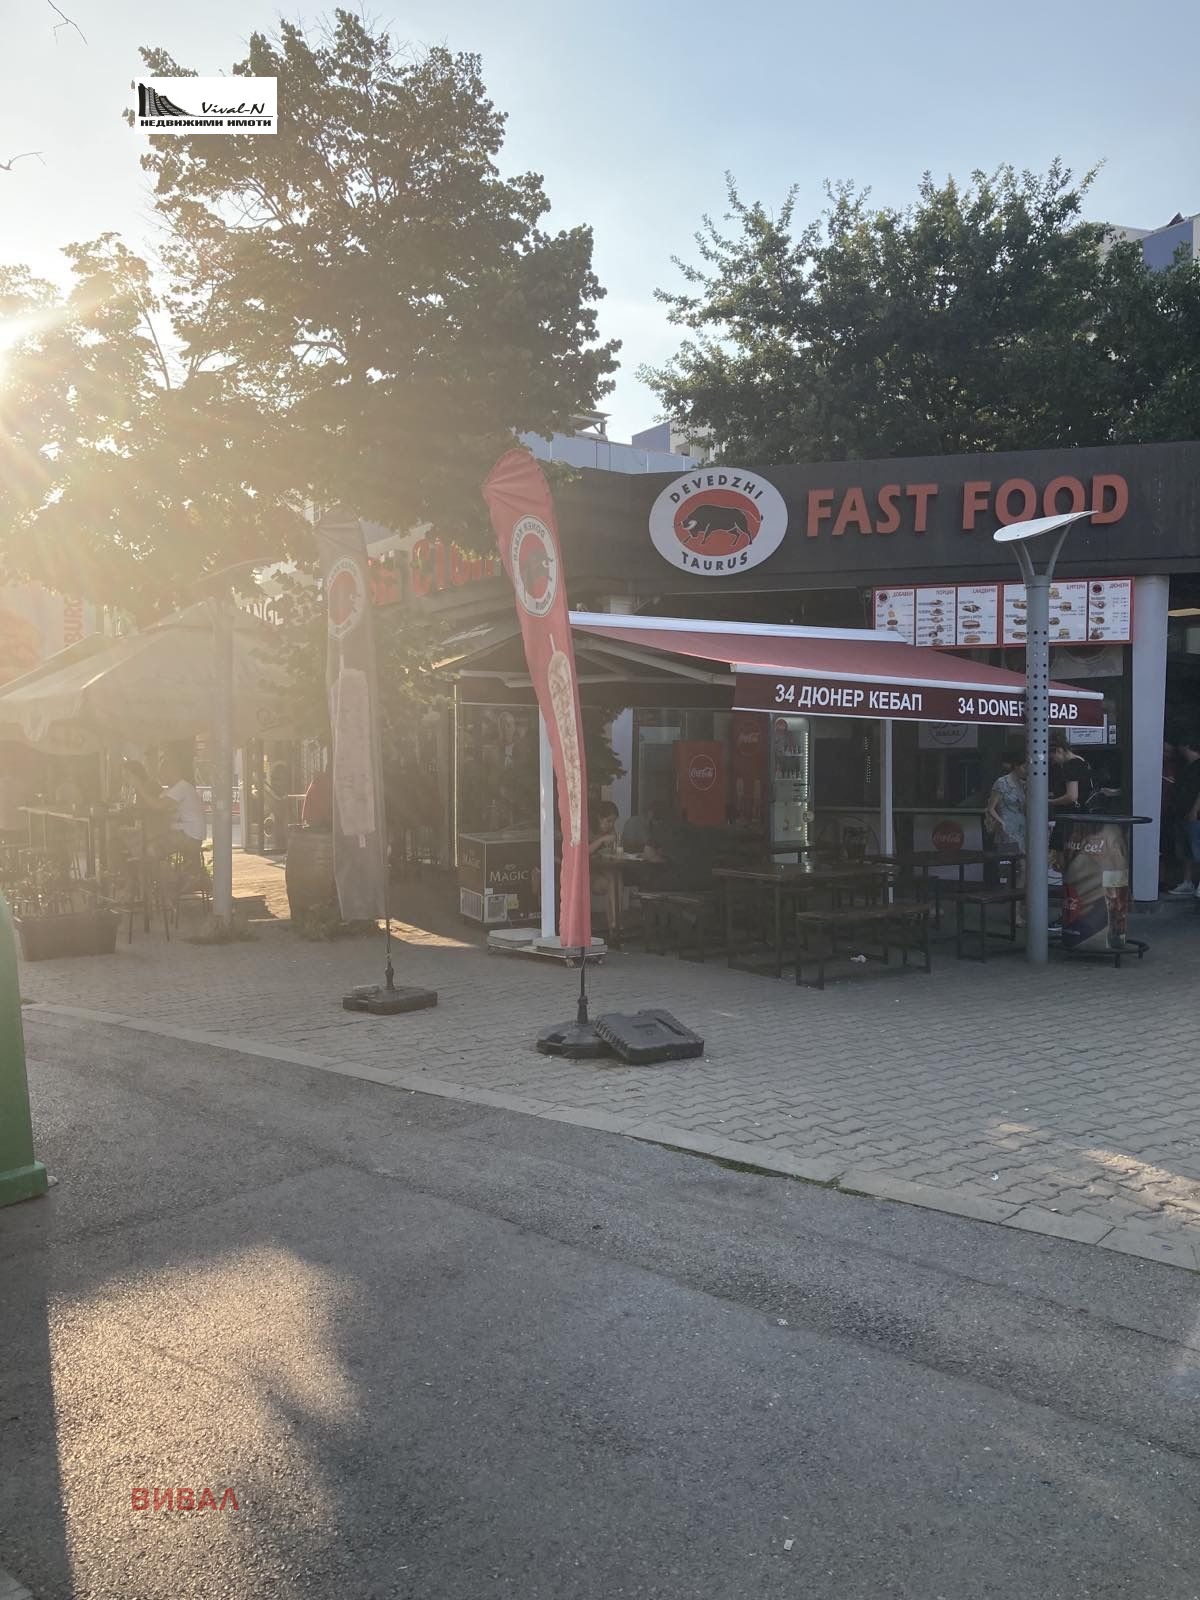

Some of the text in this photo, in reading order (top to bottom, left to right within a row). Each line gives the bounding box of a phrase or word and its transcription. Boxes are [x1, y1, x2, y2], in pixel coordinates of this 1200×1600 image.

[670, 475, 764, 503] DEVEDZHI
[806, 474, 1130, 537] FAST FOOD
[682, 552, 748, 571] TAURUS
[775, 683, 922, 711] 34 ДЮНЕР КЕБАП
[958, 697, 974, 714] 34
[1047, 703, 1078, 720] BAB
[490, 871, 529, 882] MAGIC
